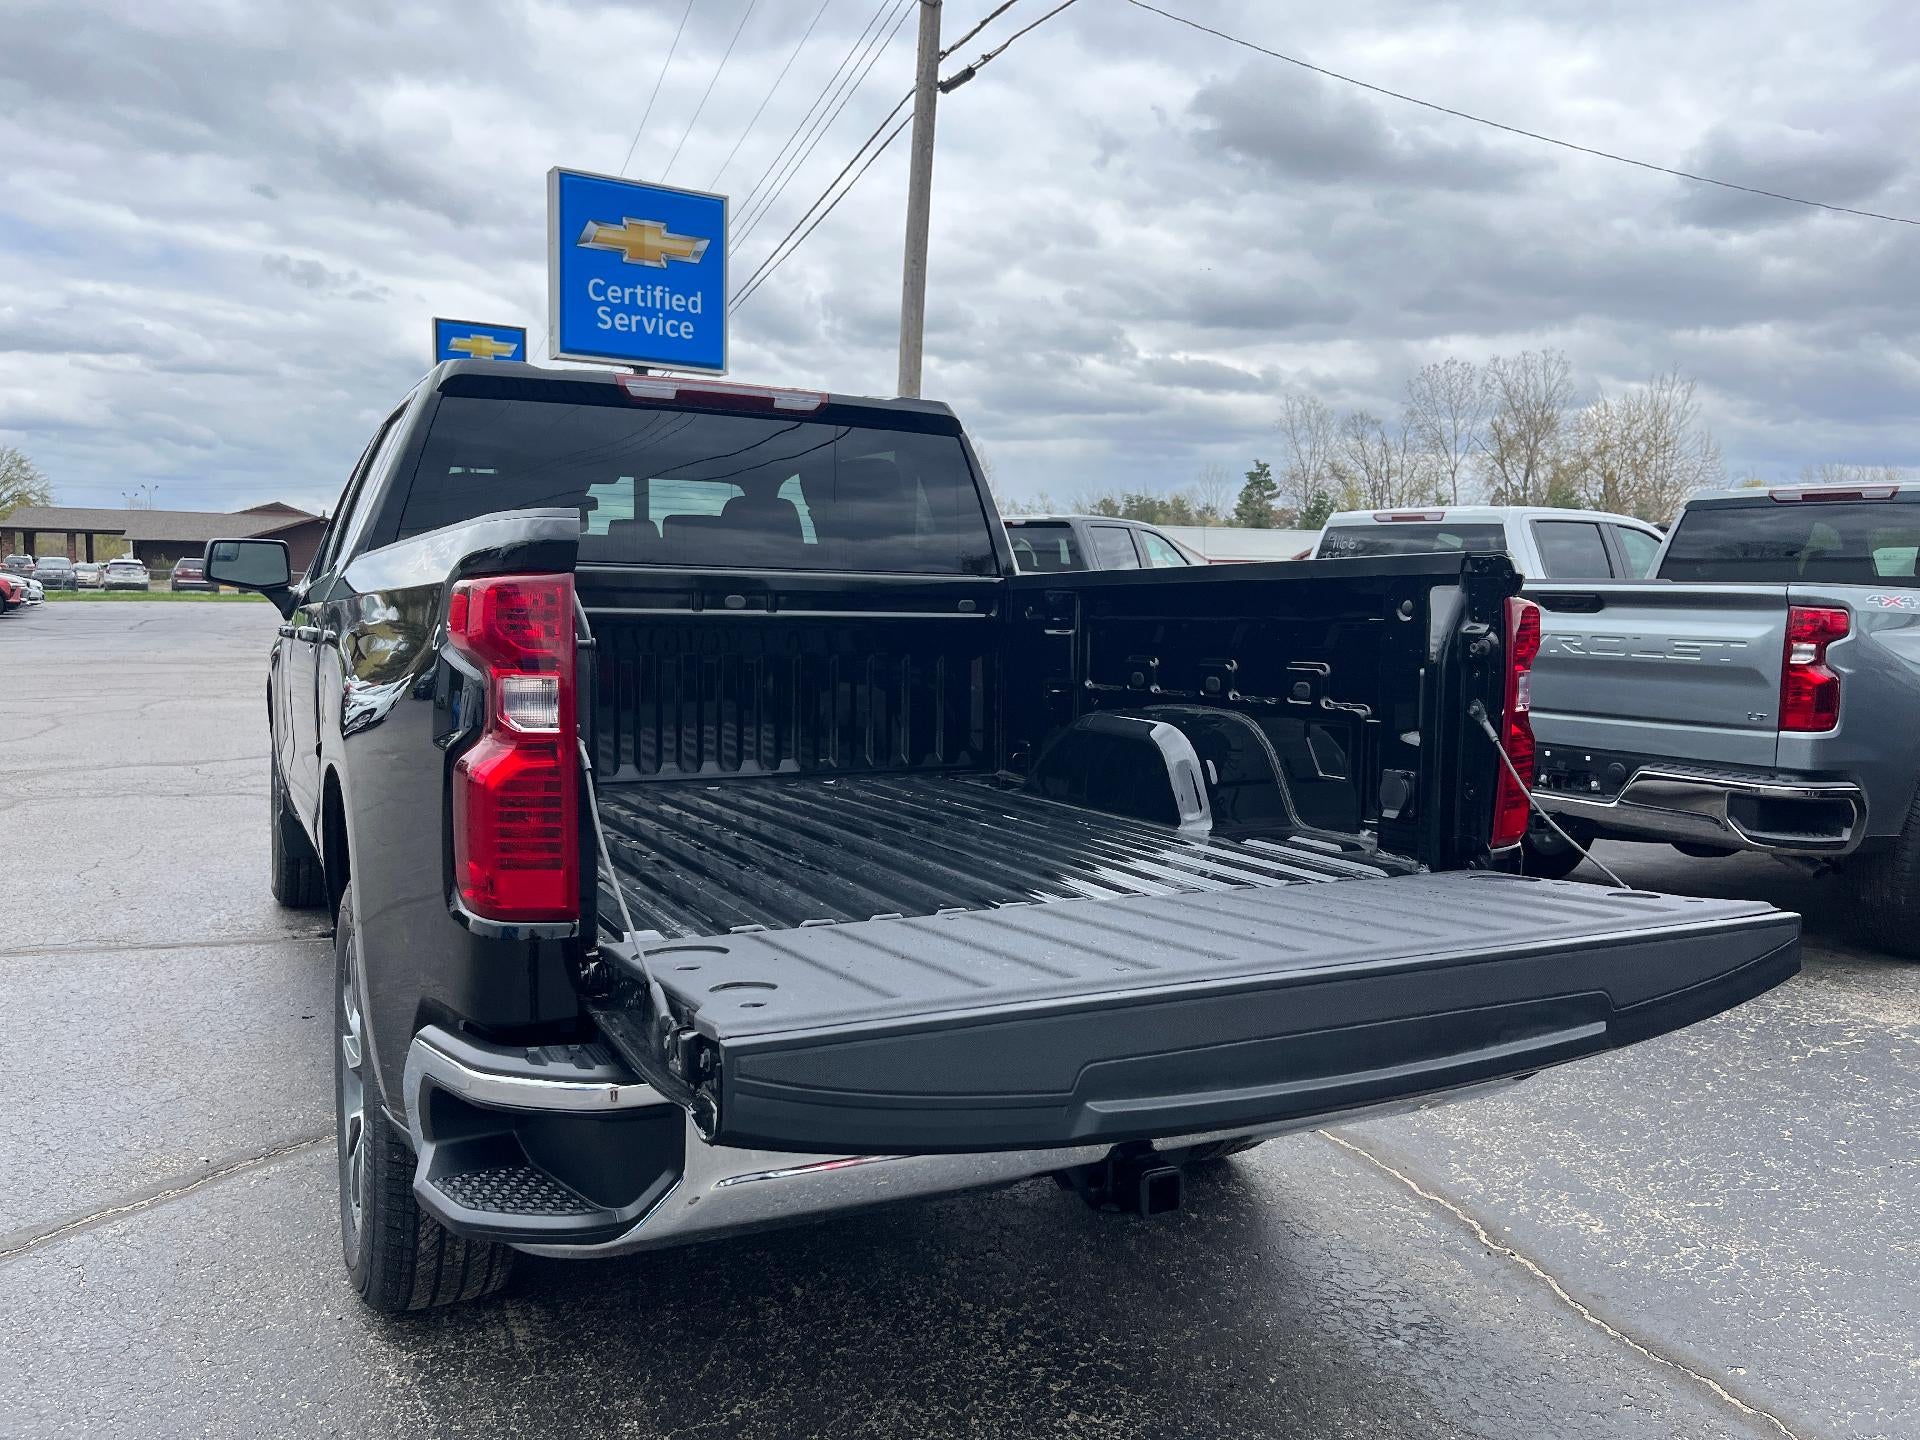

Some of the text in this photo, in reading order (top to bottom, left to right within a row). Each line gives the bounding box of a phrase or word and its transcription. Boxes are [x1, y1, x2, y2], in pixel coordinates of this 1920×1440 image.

[588, 278, 702, 314] Certified
[597, 306, 694, 339] Service
[1540, 634, 1749, 661] ROLET
